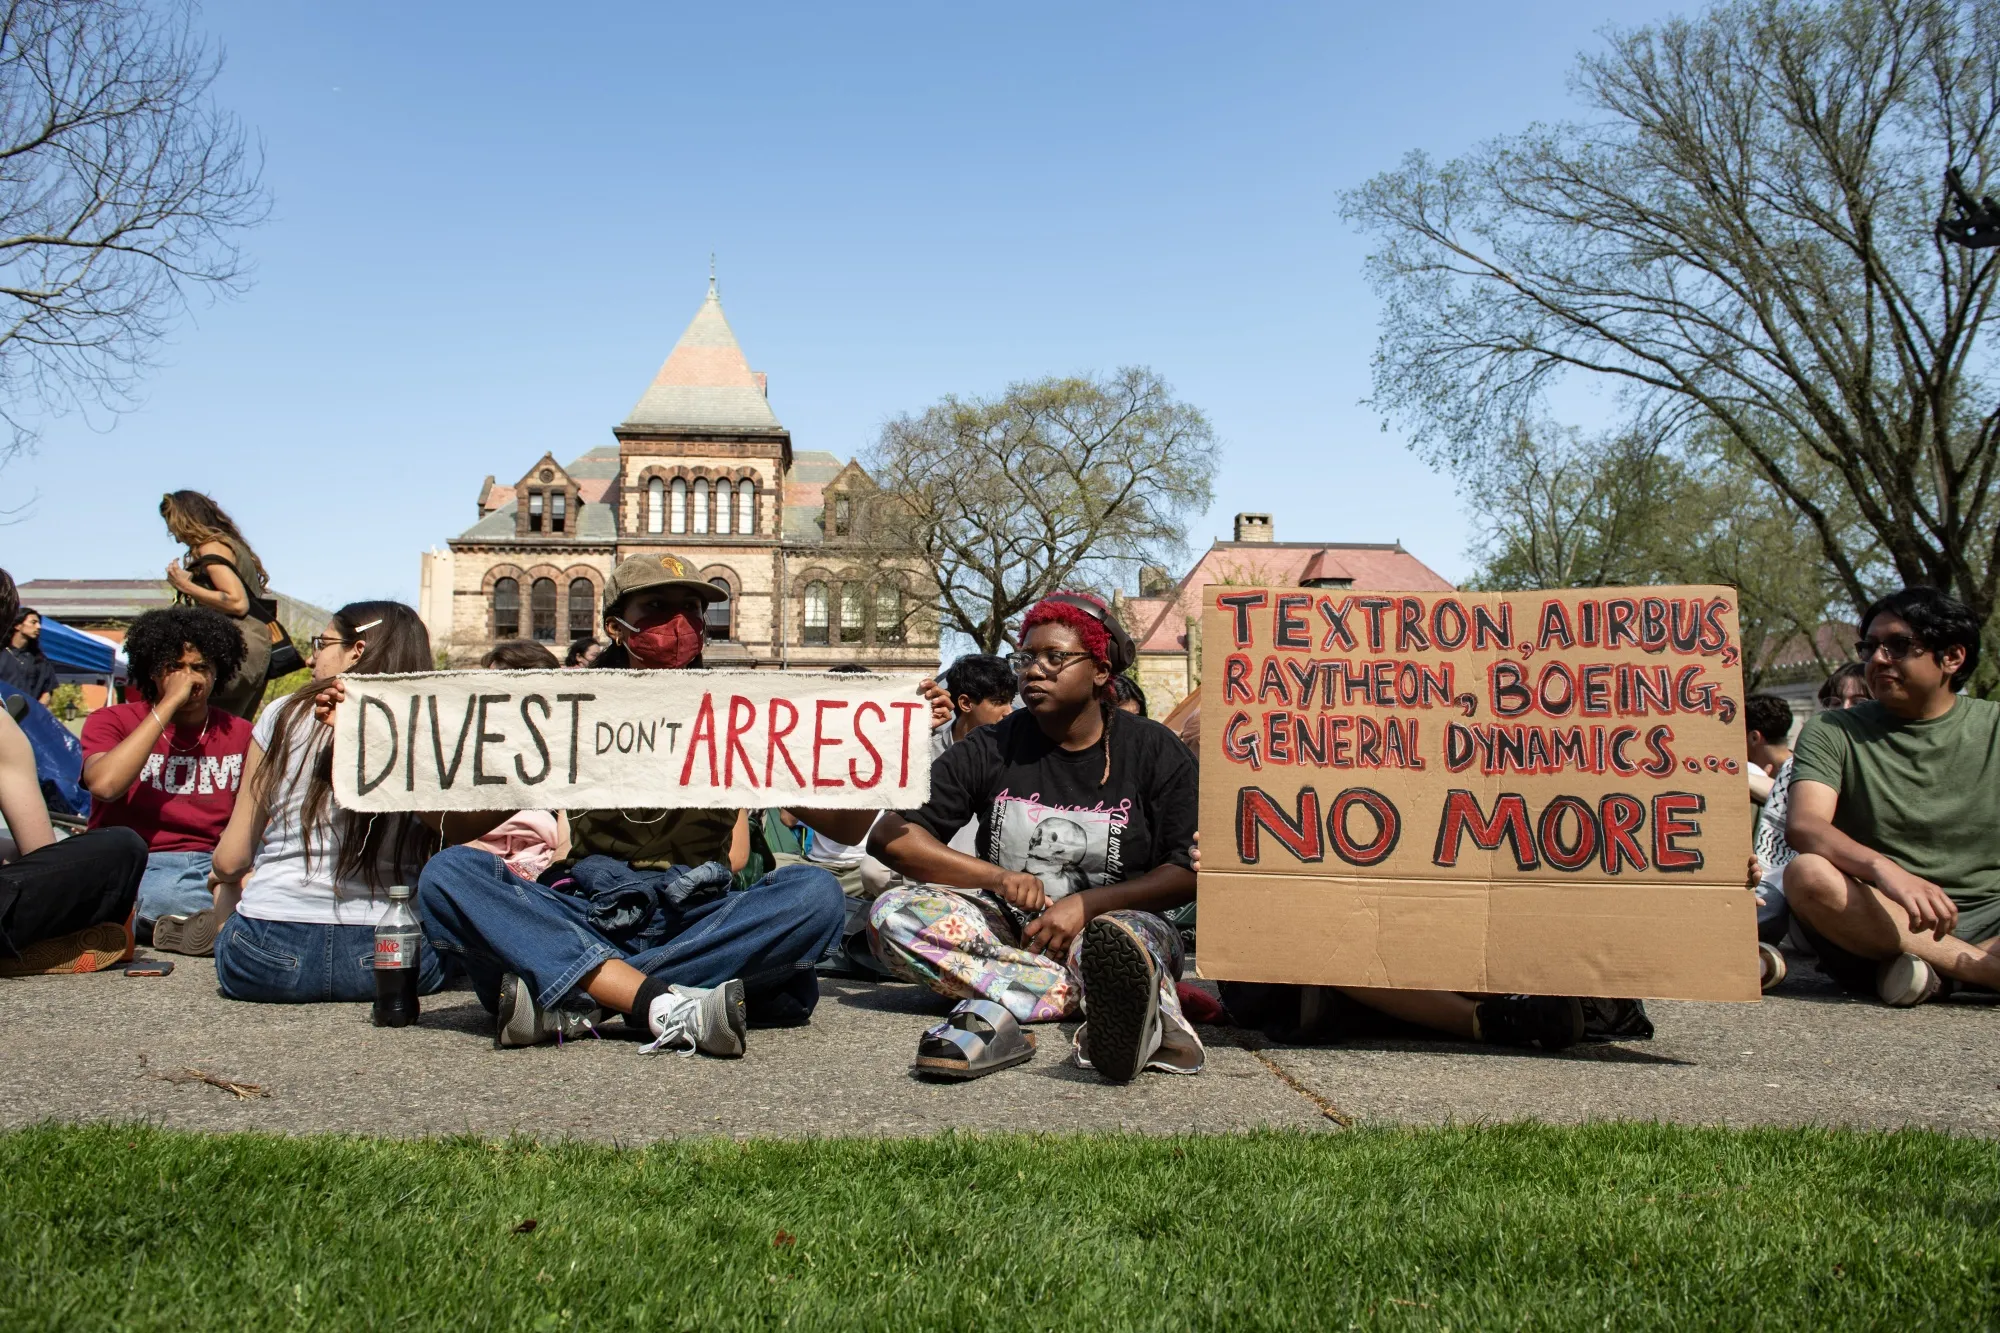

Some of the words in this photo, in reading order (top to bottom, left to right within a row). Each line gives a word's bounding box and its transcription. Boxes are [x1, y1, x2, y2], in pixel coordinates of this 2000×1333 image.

[1217, 589, 1534, 660] TEXTRON,
[1534, 596, 1740, 668] AIRBUS,
[1223, 652, 1478, 717] RAYTHEON,
[1487, 659, 1737, 724] BOEING,
[356, 693, 596, 796] DIVEST
[594, 716, 683, 755] DON'T
[679, 692, 923, 790] ARREST
[1222, 710, 1426, 770] GENERAL
[1444, 723, 1740, 779] DYNAMICS...
[1106, 836, 1124, 873] world
[1109, 812, 1128, 835] The
[1236, 785, 1401, 866] NO
[1432, 788, 1706, 875] MORE
[375, 939, 400, 953] oke
